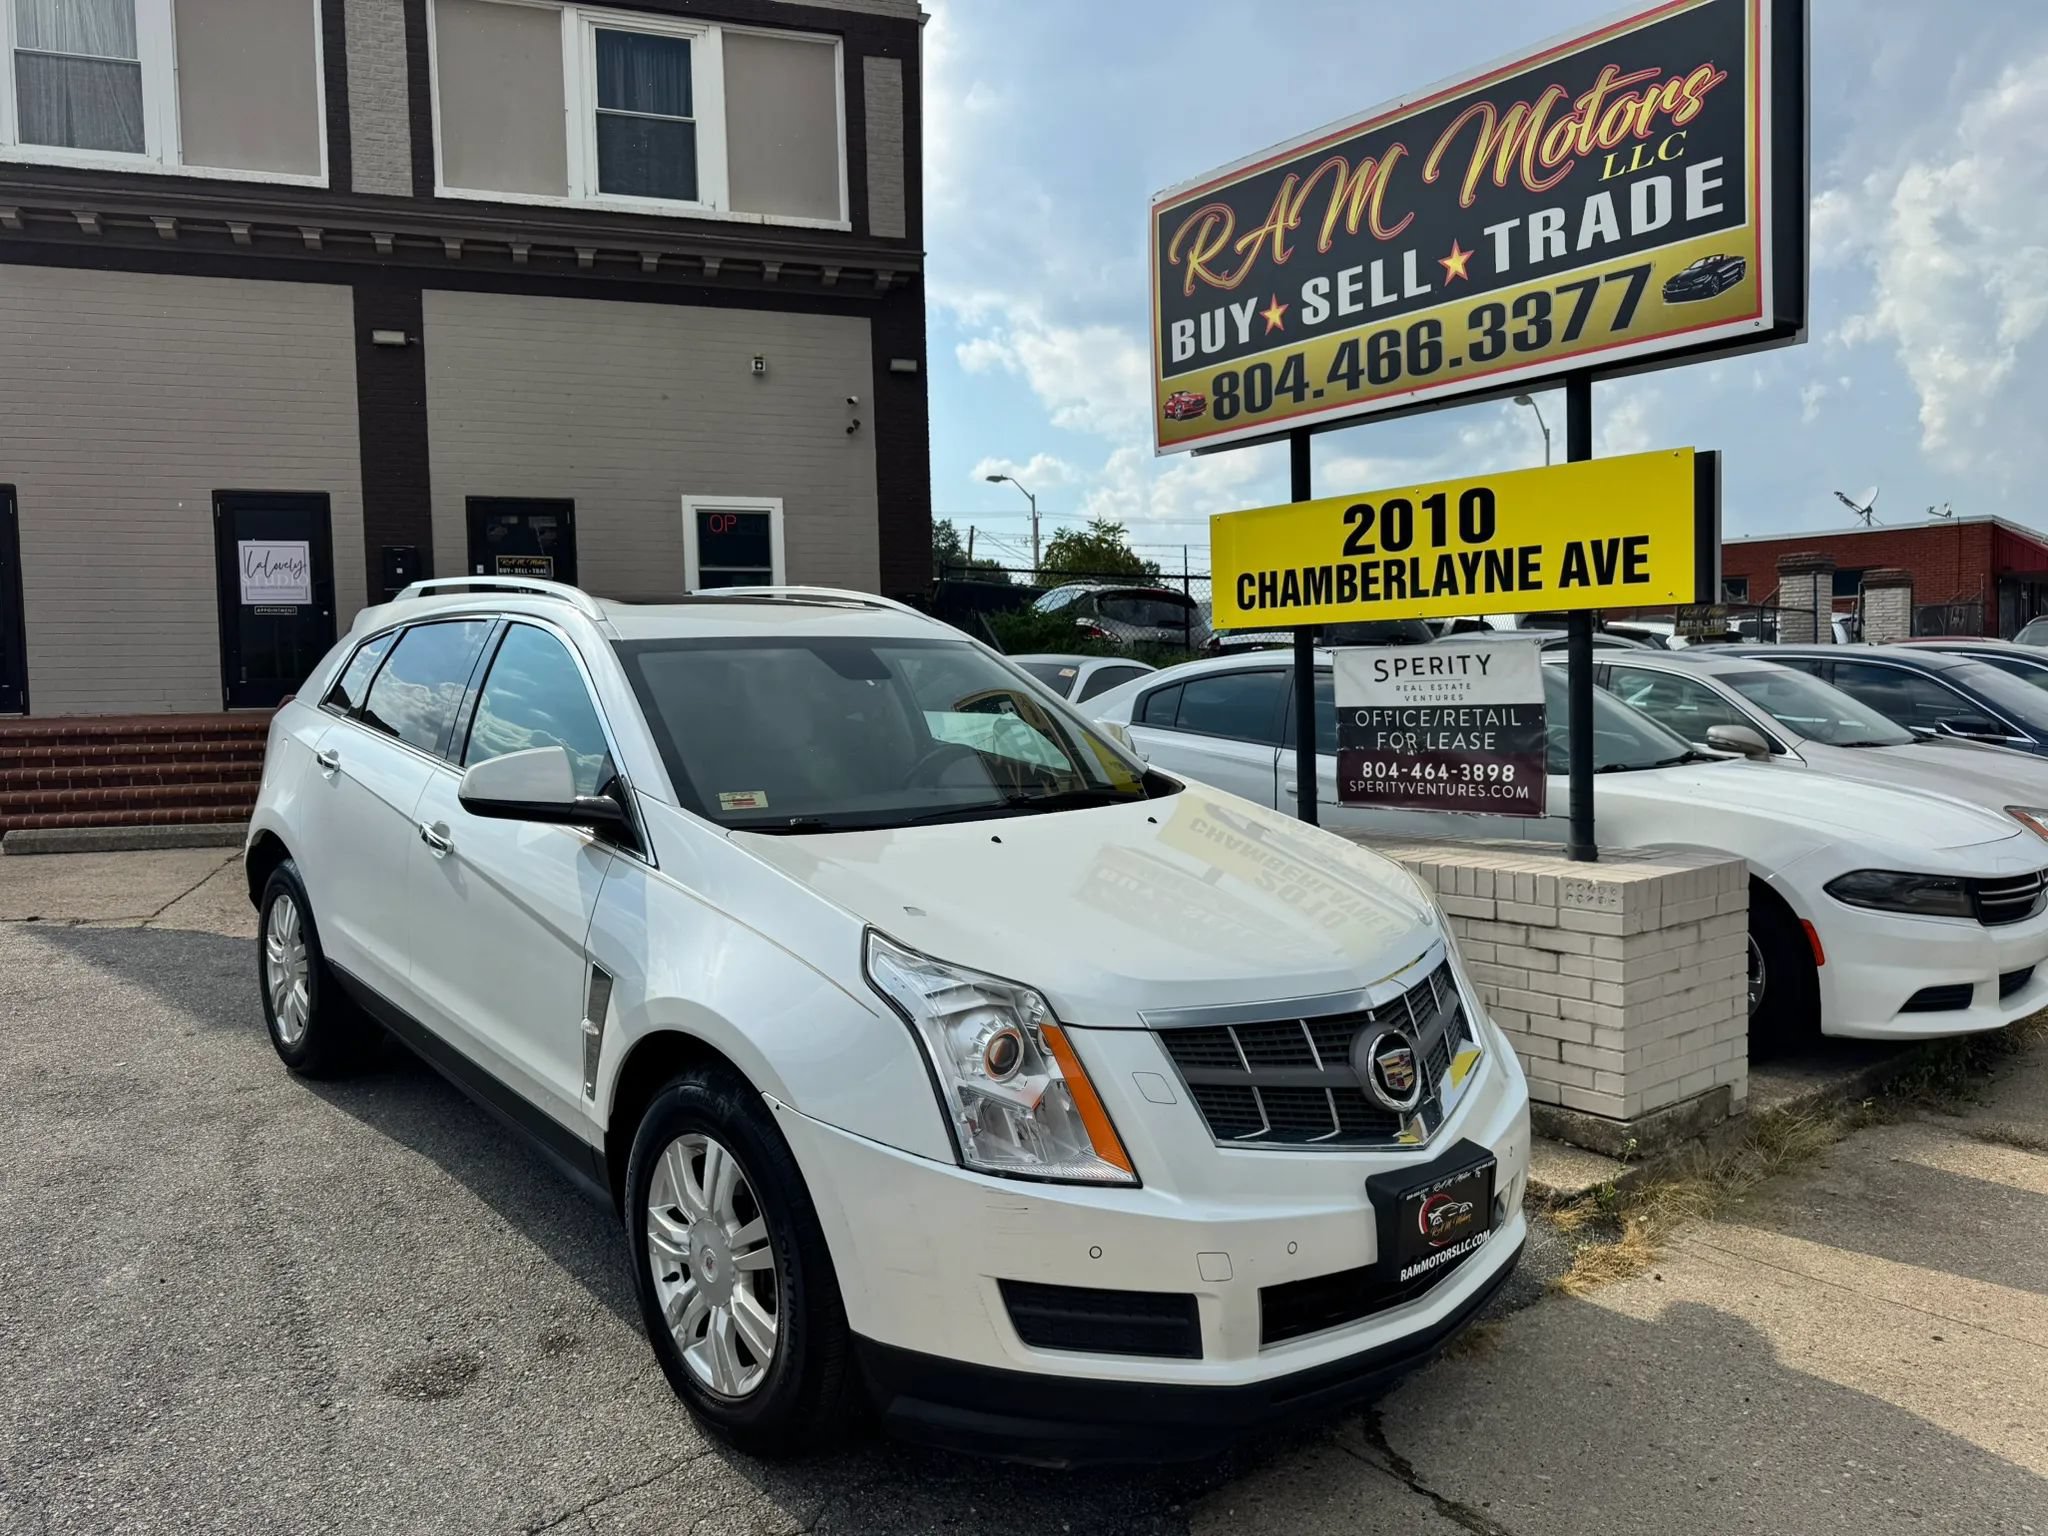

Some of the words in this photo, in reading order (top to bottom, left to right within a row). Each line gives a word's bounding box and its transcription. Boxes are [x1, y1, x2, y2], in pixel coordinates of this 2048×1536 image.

[1599, 129, 1687, 182] LLC
[1168, 143, 1414, 295] RAM
[1421, 62, 1727, 208] Motors
[1171, 297, 1259, 363] BUY
[1301, 250, 1431, 326] SELL
[1484, 157, 1724, 272] TRADE
[1211, 262, 1654, 421] 804.466.3377
[1343, 487, 1496, 557] 2010
[1236, 545, 1542, 610] CHAMBERLAYNE
[1559, 535, 1650, 588] AVE
[1374, 654, 1491, 683] SPERITY
[1396, 683, 1424, 692] REAL
[1430, 683, 1471, 691] ESTATE
[1404, 694, 1465, 702] VENTURES
[1355, 708, 1522, 728] OFFICE/RETAIL
[1377, 732, 1417, 750] FOR
[1426, 732, 1496, 750] LEASE
[1362, 761, 1515, 782] 804-464-3898
[1349, 780, 1529, 799] SPERITYVENTURES.COM
